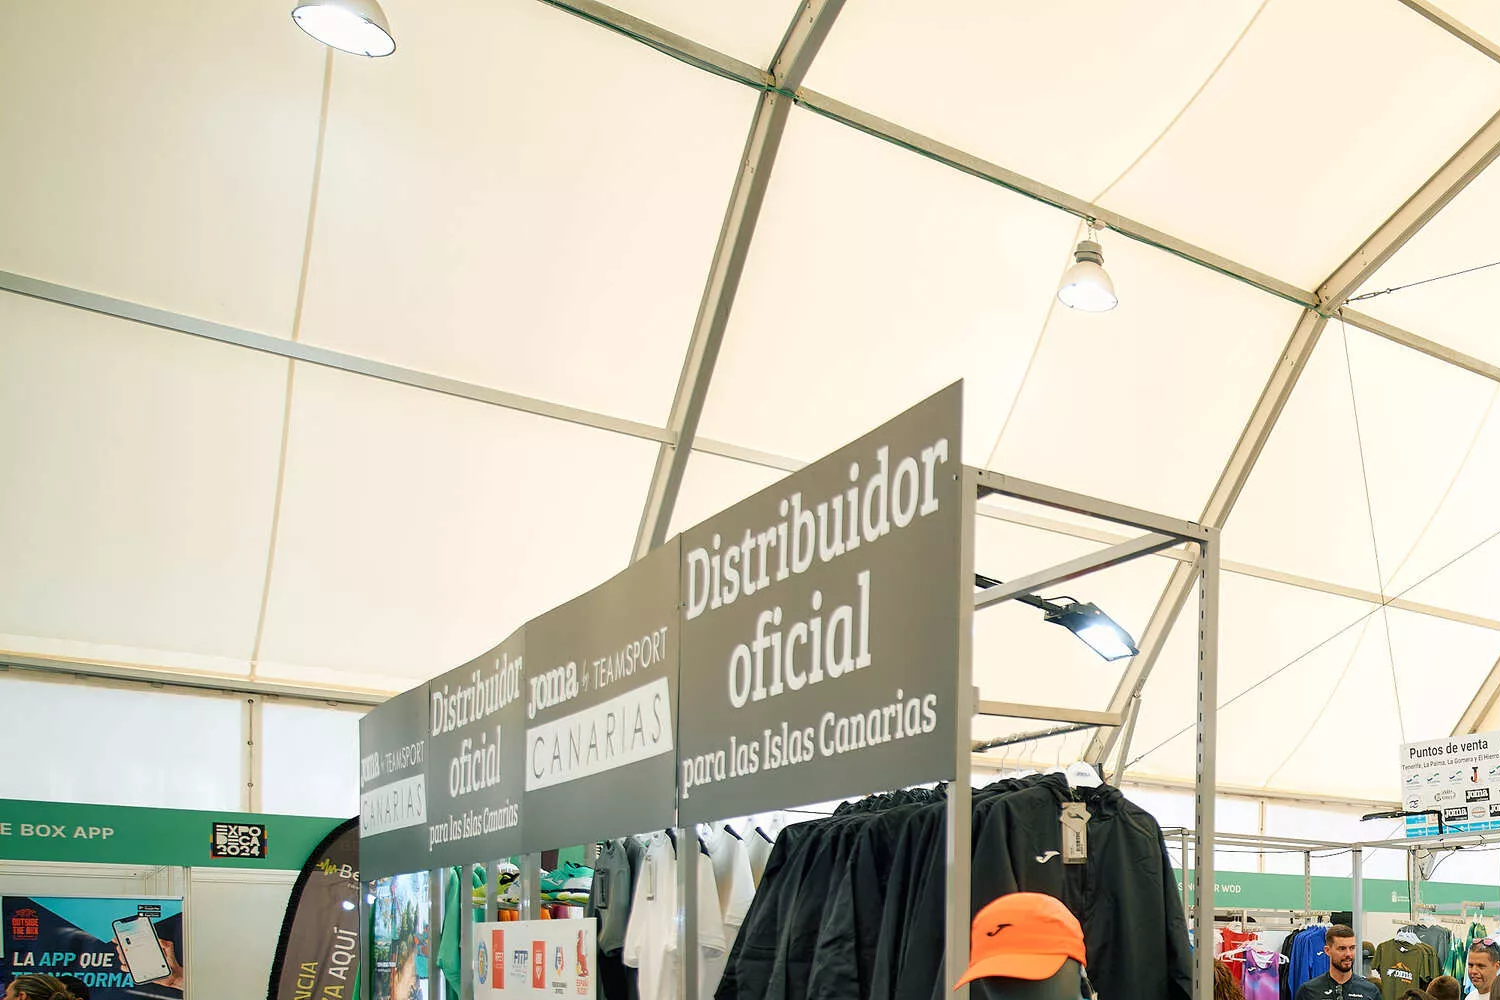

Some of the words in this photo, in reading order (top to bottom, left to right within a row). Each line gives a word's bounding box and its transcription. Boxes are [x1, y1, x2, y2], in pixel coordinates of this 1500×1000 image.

[685, 438, 948, 621] Distribuidor
[593, 627, 668, 690] TEAMSPORT
[728, 570, 871, 708] oficial
[432, 654, 523, 736] Distribuidor
[385, 741, 425, 775] TEAMSPORT
[532, 693, 663, 778] CANARIAS
[681, 750, 726, 799] para
[730, 736, 759, 777] las
[763, 722, 814, 771] Islas
[819, 689, 937, 757] Canarias
[1409, 746, 1444, 759] Puntos
[1446, 742, 1458, 754] de
[1461, 740, 1489, 752] venta
[450, 725, 502, 797] oficial
[363, 782, 423, 829] CANARIAS
[429, 821, 448, 850] para
[450, 814, 462, 841] las
[463, 809, 482, 836] Islas
[483, 799, 518, 833] Canarias
[20, 823, 67, 838] BOX
[73, 826, 115, 840] APP
[216, 824, 261, 837] EXPO
[216, 835, 260, 846] DECA
[216, 845, 260, 856] 2024
[1222, 884, 1242, 893] WOD
[13, 952, 35, 966] LA
[39, 952, 76, 966] APP
[80, 952, 115, 968] QUE
